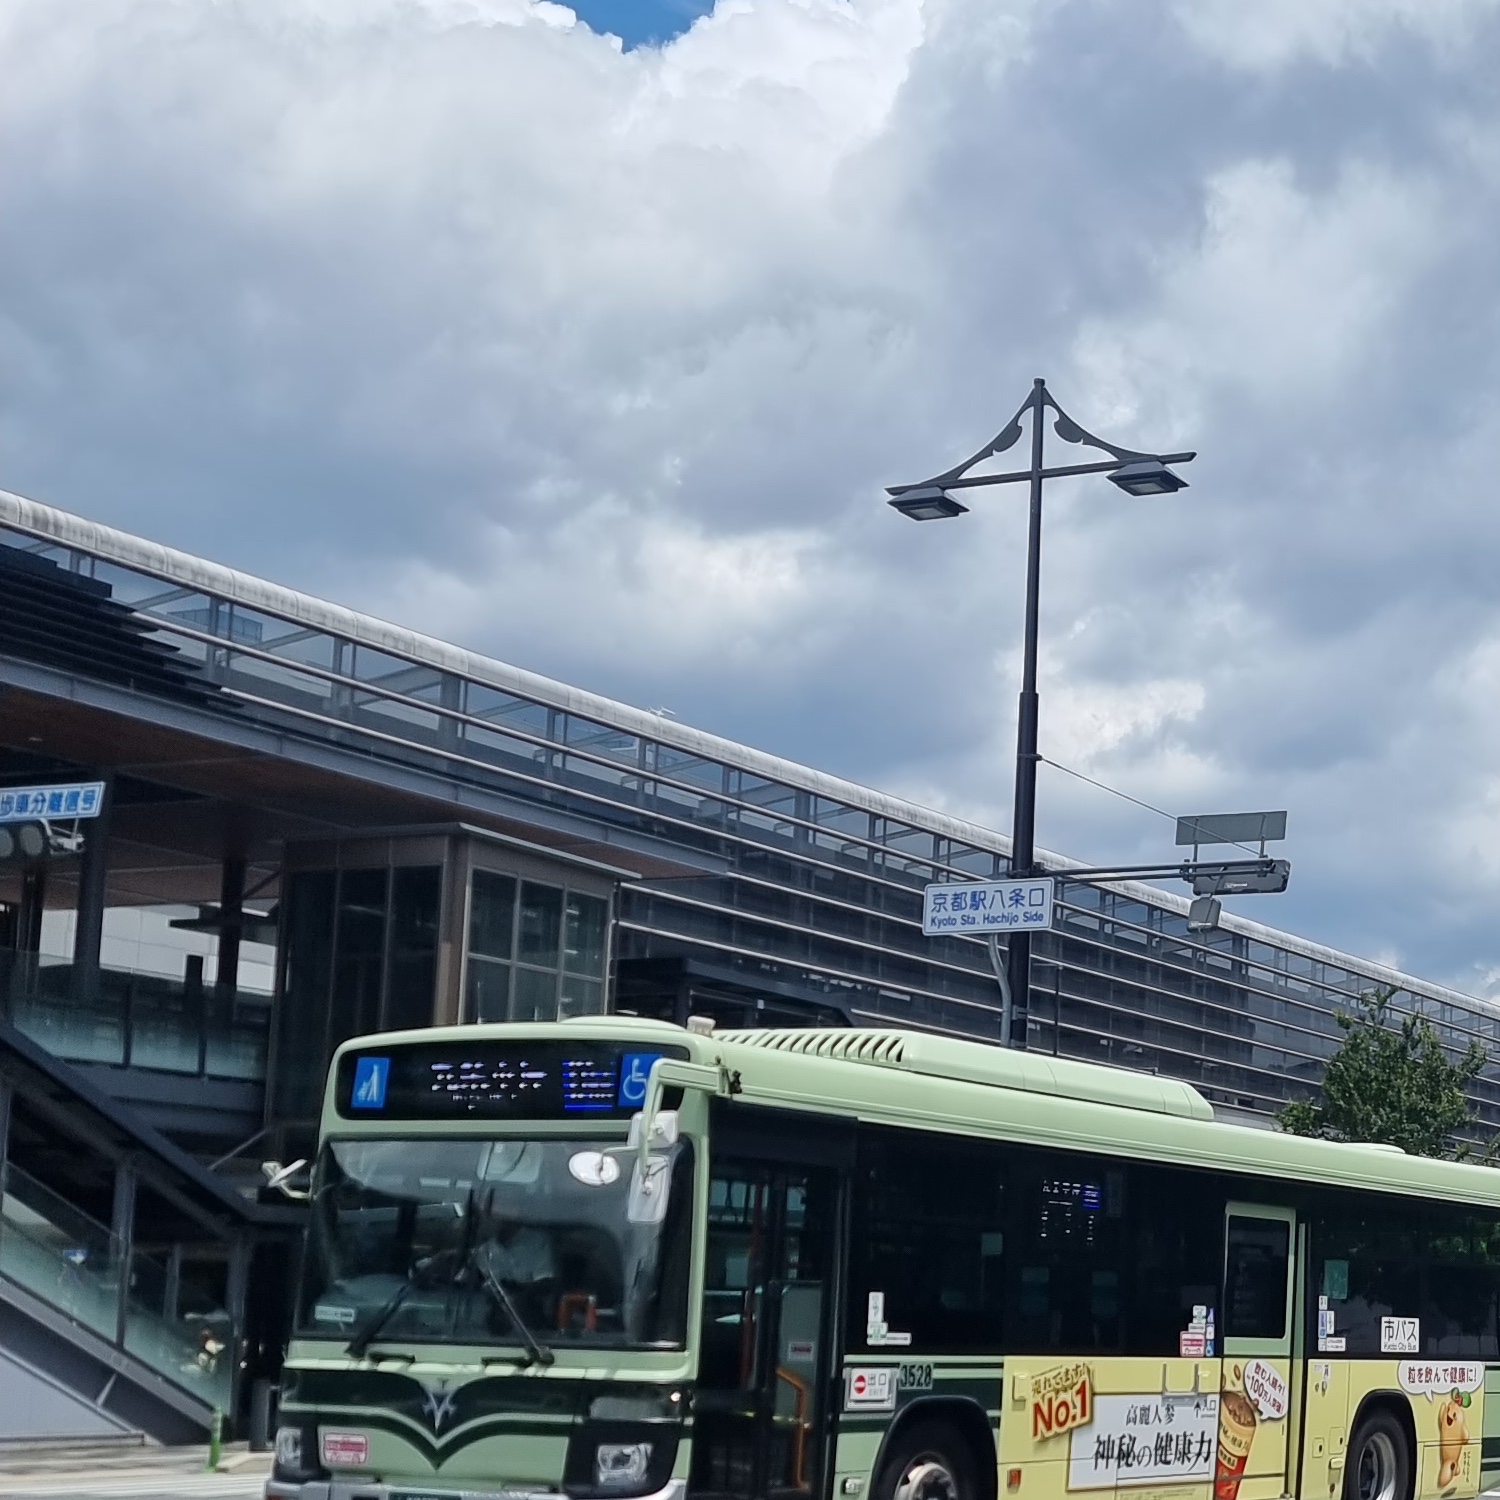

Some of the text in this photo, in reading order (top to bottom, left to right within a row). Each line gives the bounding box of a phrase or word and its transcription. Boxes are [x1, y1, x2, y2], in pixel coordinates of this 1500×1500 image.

[930, 887, 1045, 913] 京都駅八条口
[930, 910, 1045, 929] Kyoto Sta. Hachijo Side
[1383, 1319, 1417, 1342] 市バス
[867, 1373, 887, 1385] 出口
[900, 1364, 933, 1389] 3528
[1407, 1365, 1477, 1385] 粒を飲んで健康に!
[1032, 1378, 1087, 1438] No.1
[1093, 1429, 1212, 1472] 神秘の健康力
